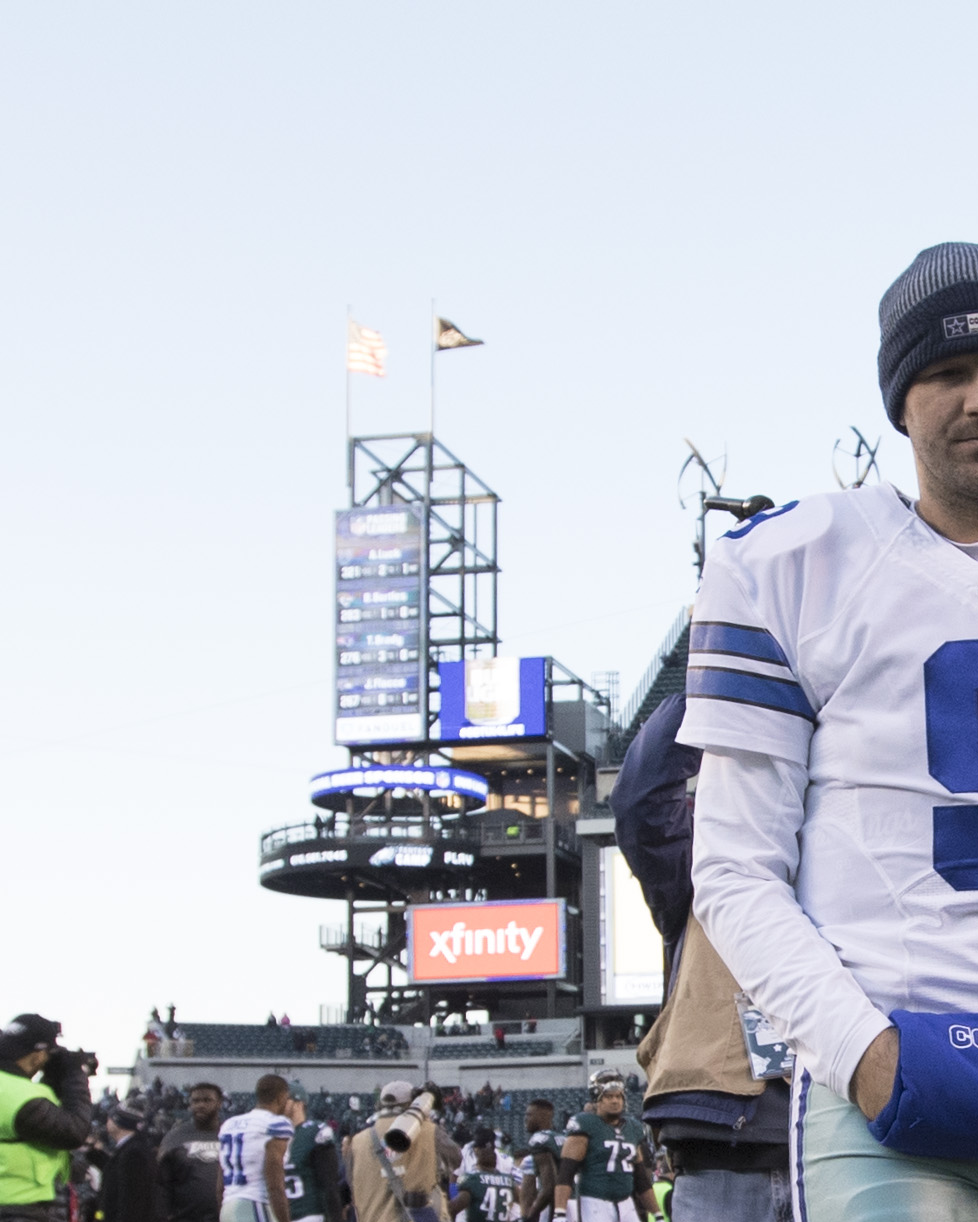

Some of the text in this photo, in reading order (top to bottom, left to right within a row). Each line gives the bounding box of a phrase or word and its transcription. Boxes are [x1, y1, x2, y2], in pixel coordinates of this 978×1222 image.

[428, 920, 544, 964] xfinity
[603, 1140, 637, 1172] 72
[480, 1186, 513, 1221] 43
